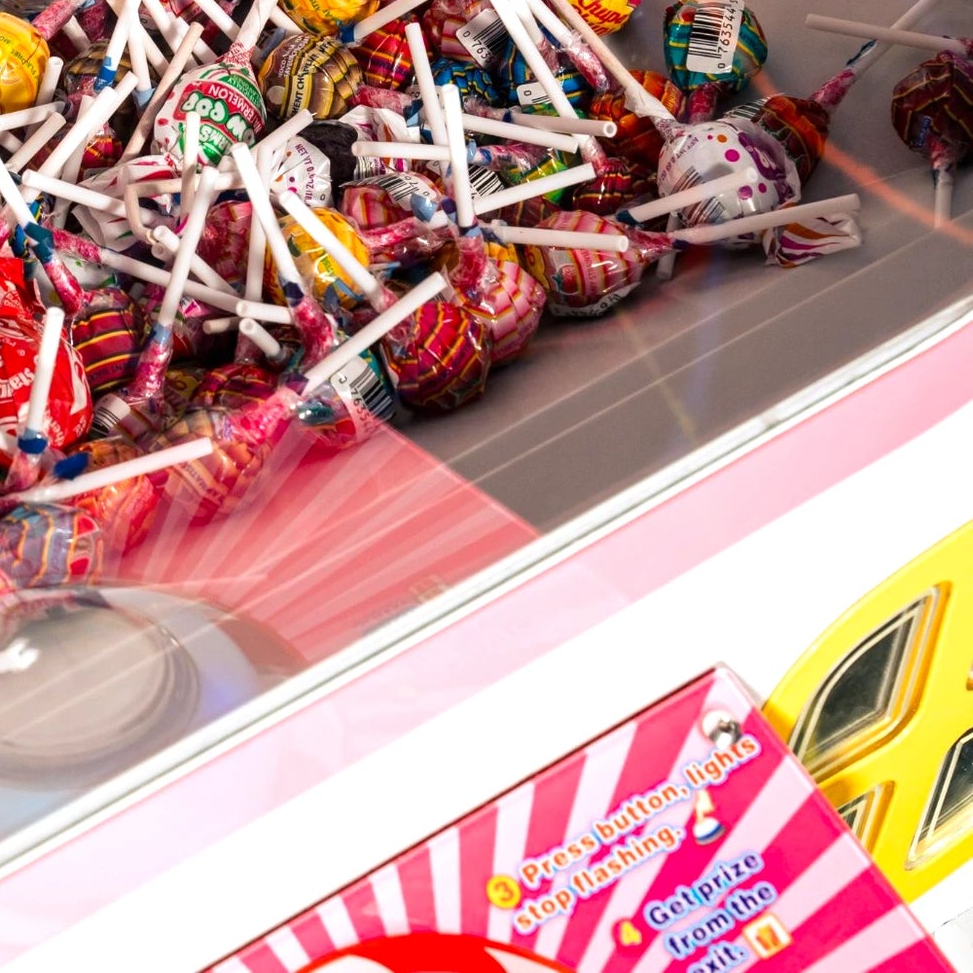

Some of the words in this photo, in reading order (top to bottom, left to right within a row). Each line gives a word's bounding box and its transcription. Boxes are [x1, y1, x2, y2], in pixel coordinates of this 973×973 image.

[716, 9, 737, 54] 763544
[491, 878, 517, 906] 3
[521, 834, 596, 883] Press
[595, 783, 690, 841] button,
[684, 737, 757, 785] lights
[515, 890, 572, 929] stop
[572, 826, 683, 894] flashing.
[649, 891, 696, 926] Get
[697, 854, 759, 902] prize
[668, 912, 730, 955] from
[730, 885, 773, 916] the
